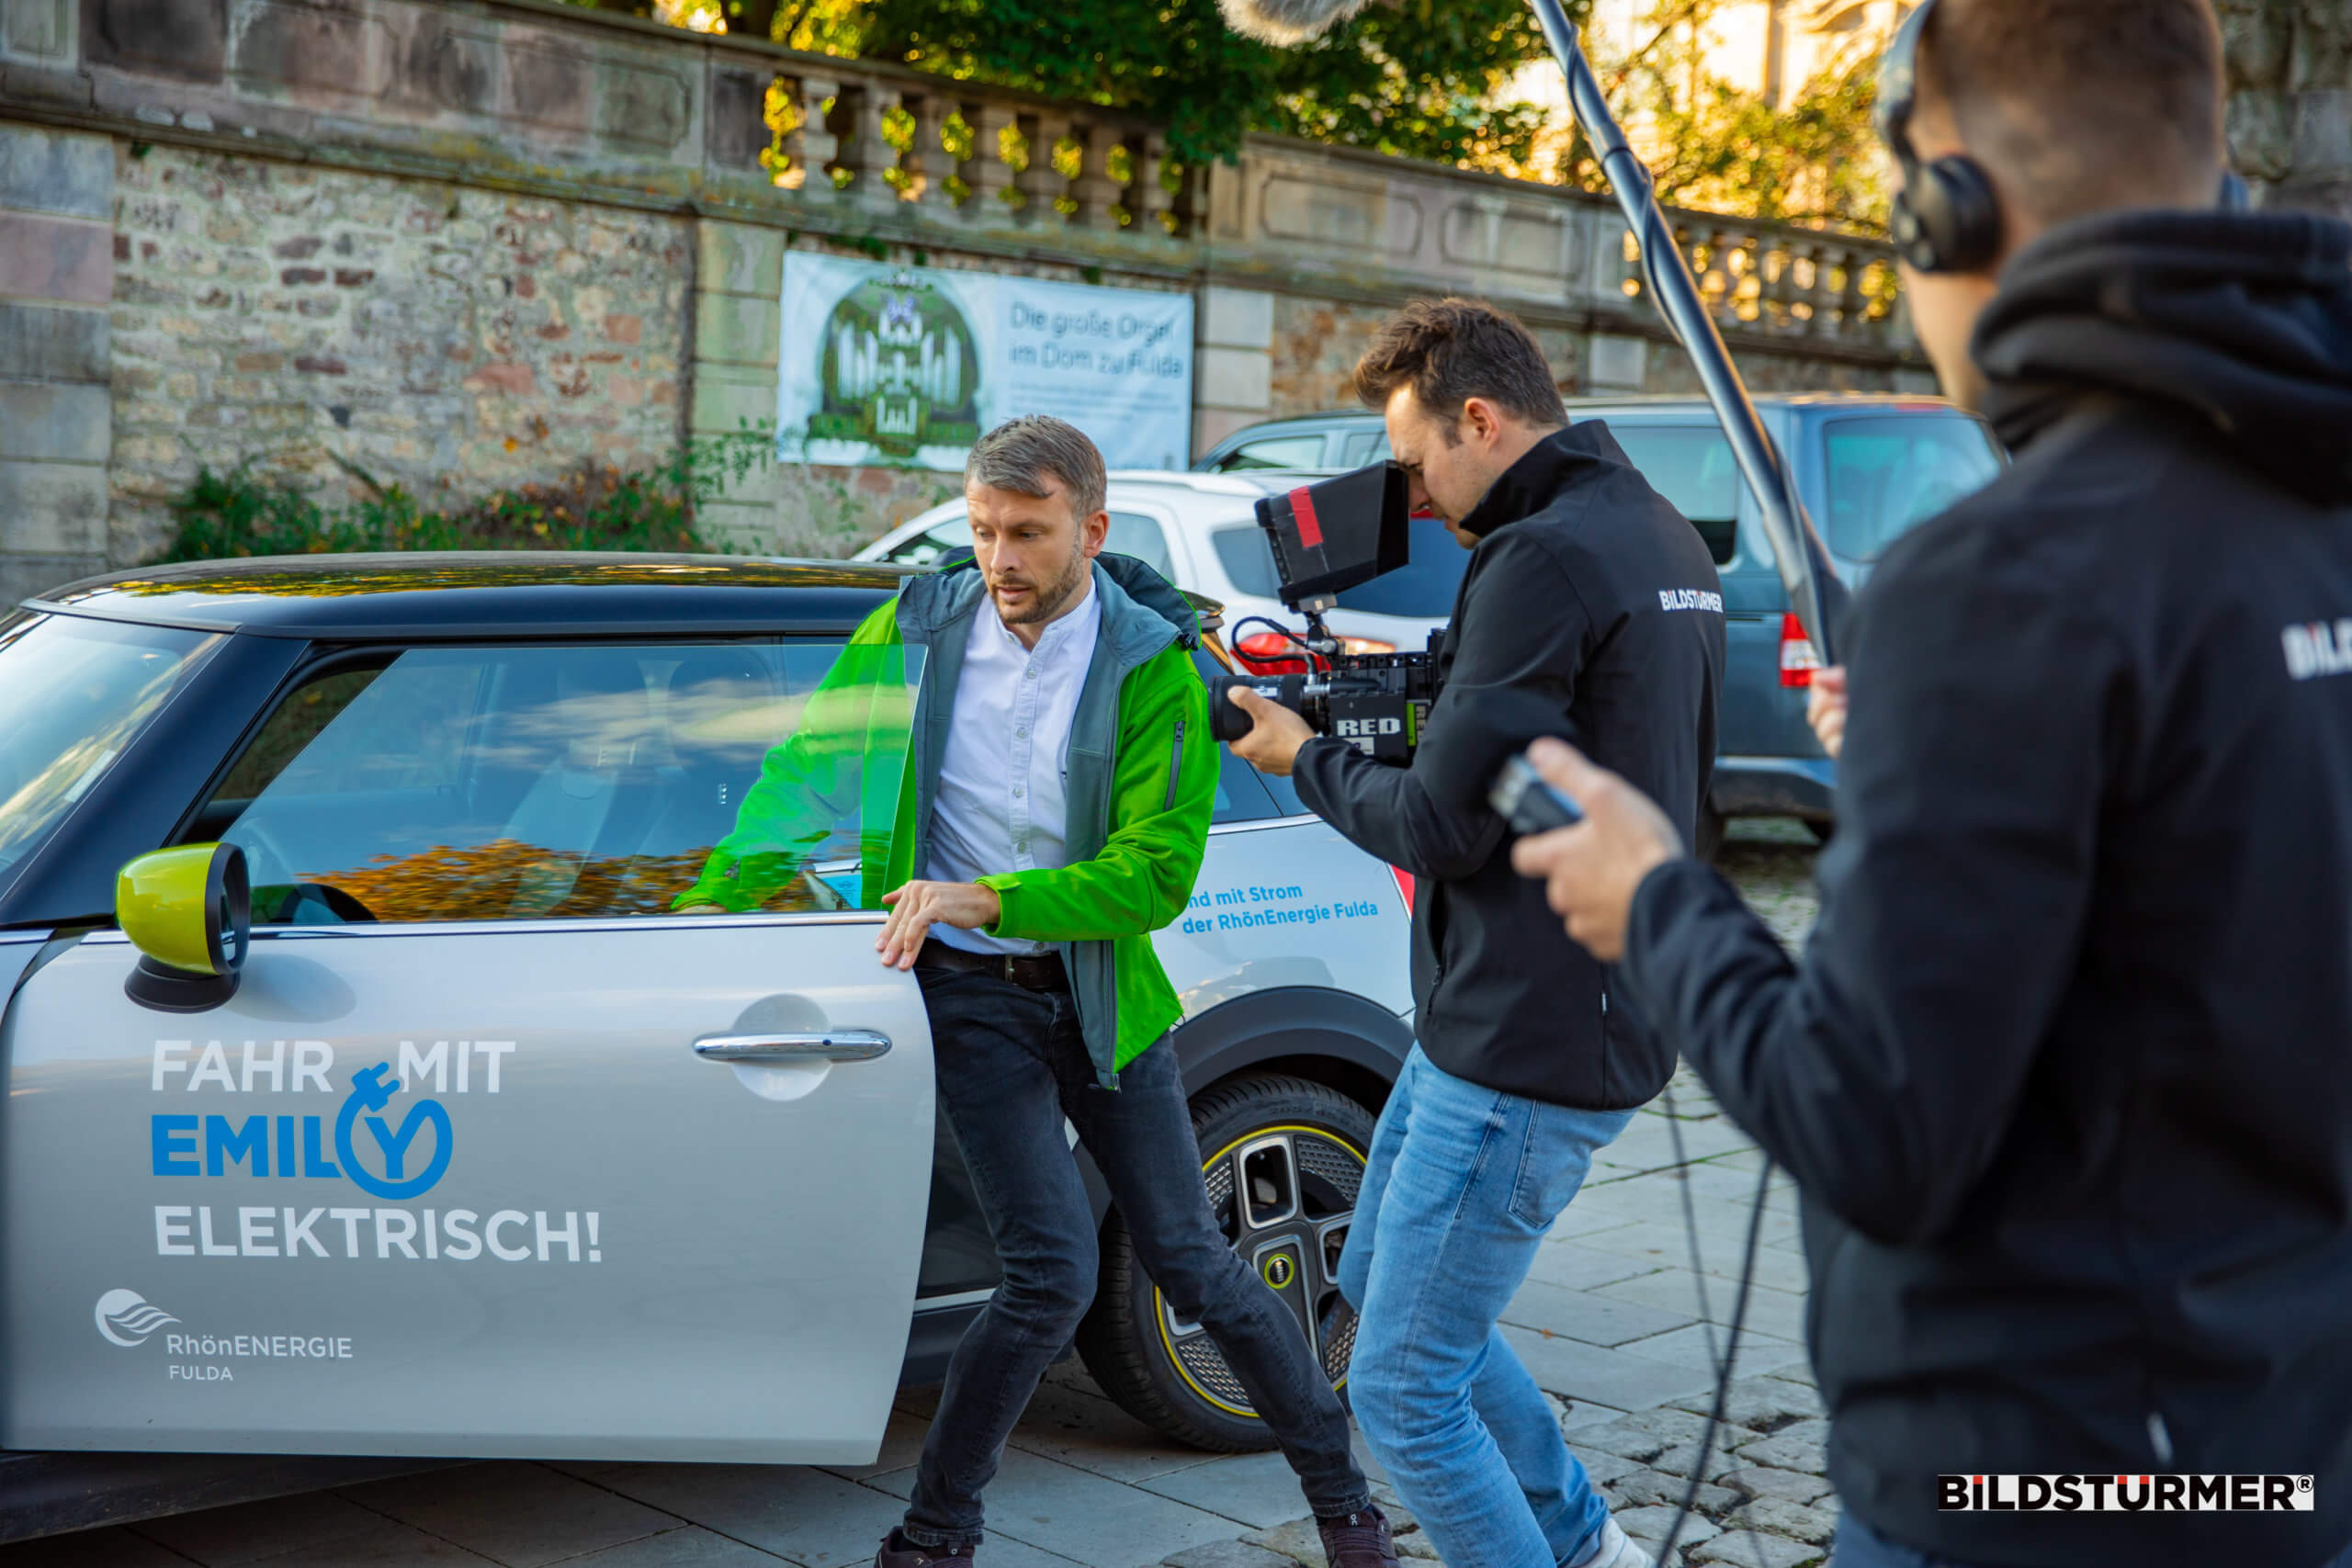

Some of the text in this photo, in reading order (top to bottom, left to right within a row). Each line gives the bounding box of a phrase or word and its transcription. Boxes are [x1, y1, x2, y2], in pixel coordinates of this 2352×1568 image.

[1010, 301, 1048, 331] Die
[1051, 309, 1114, 338] große
[1009, 340, 1037, 364] im
[1041, 342, 1093, 369] Dom
[1337, 717, 1401, 737] RED
[1216, 888, 1246, 906] mit
[1249, 885, 1303, 902] Strom
[1182, 900, 1378, 934] der RhönEnergie Fulda
[152, 1039, 517, 1094] FAHR MIT
[151, 1099, 454, 1201] EMILY
[154, 1204, 603, 1264] ELEKTRISCH!
[165, 1333, 354, 1359] RhönENERGIE
[168, 1364, 233, 1382] FULDA
